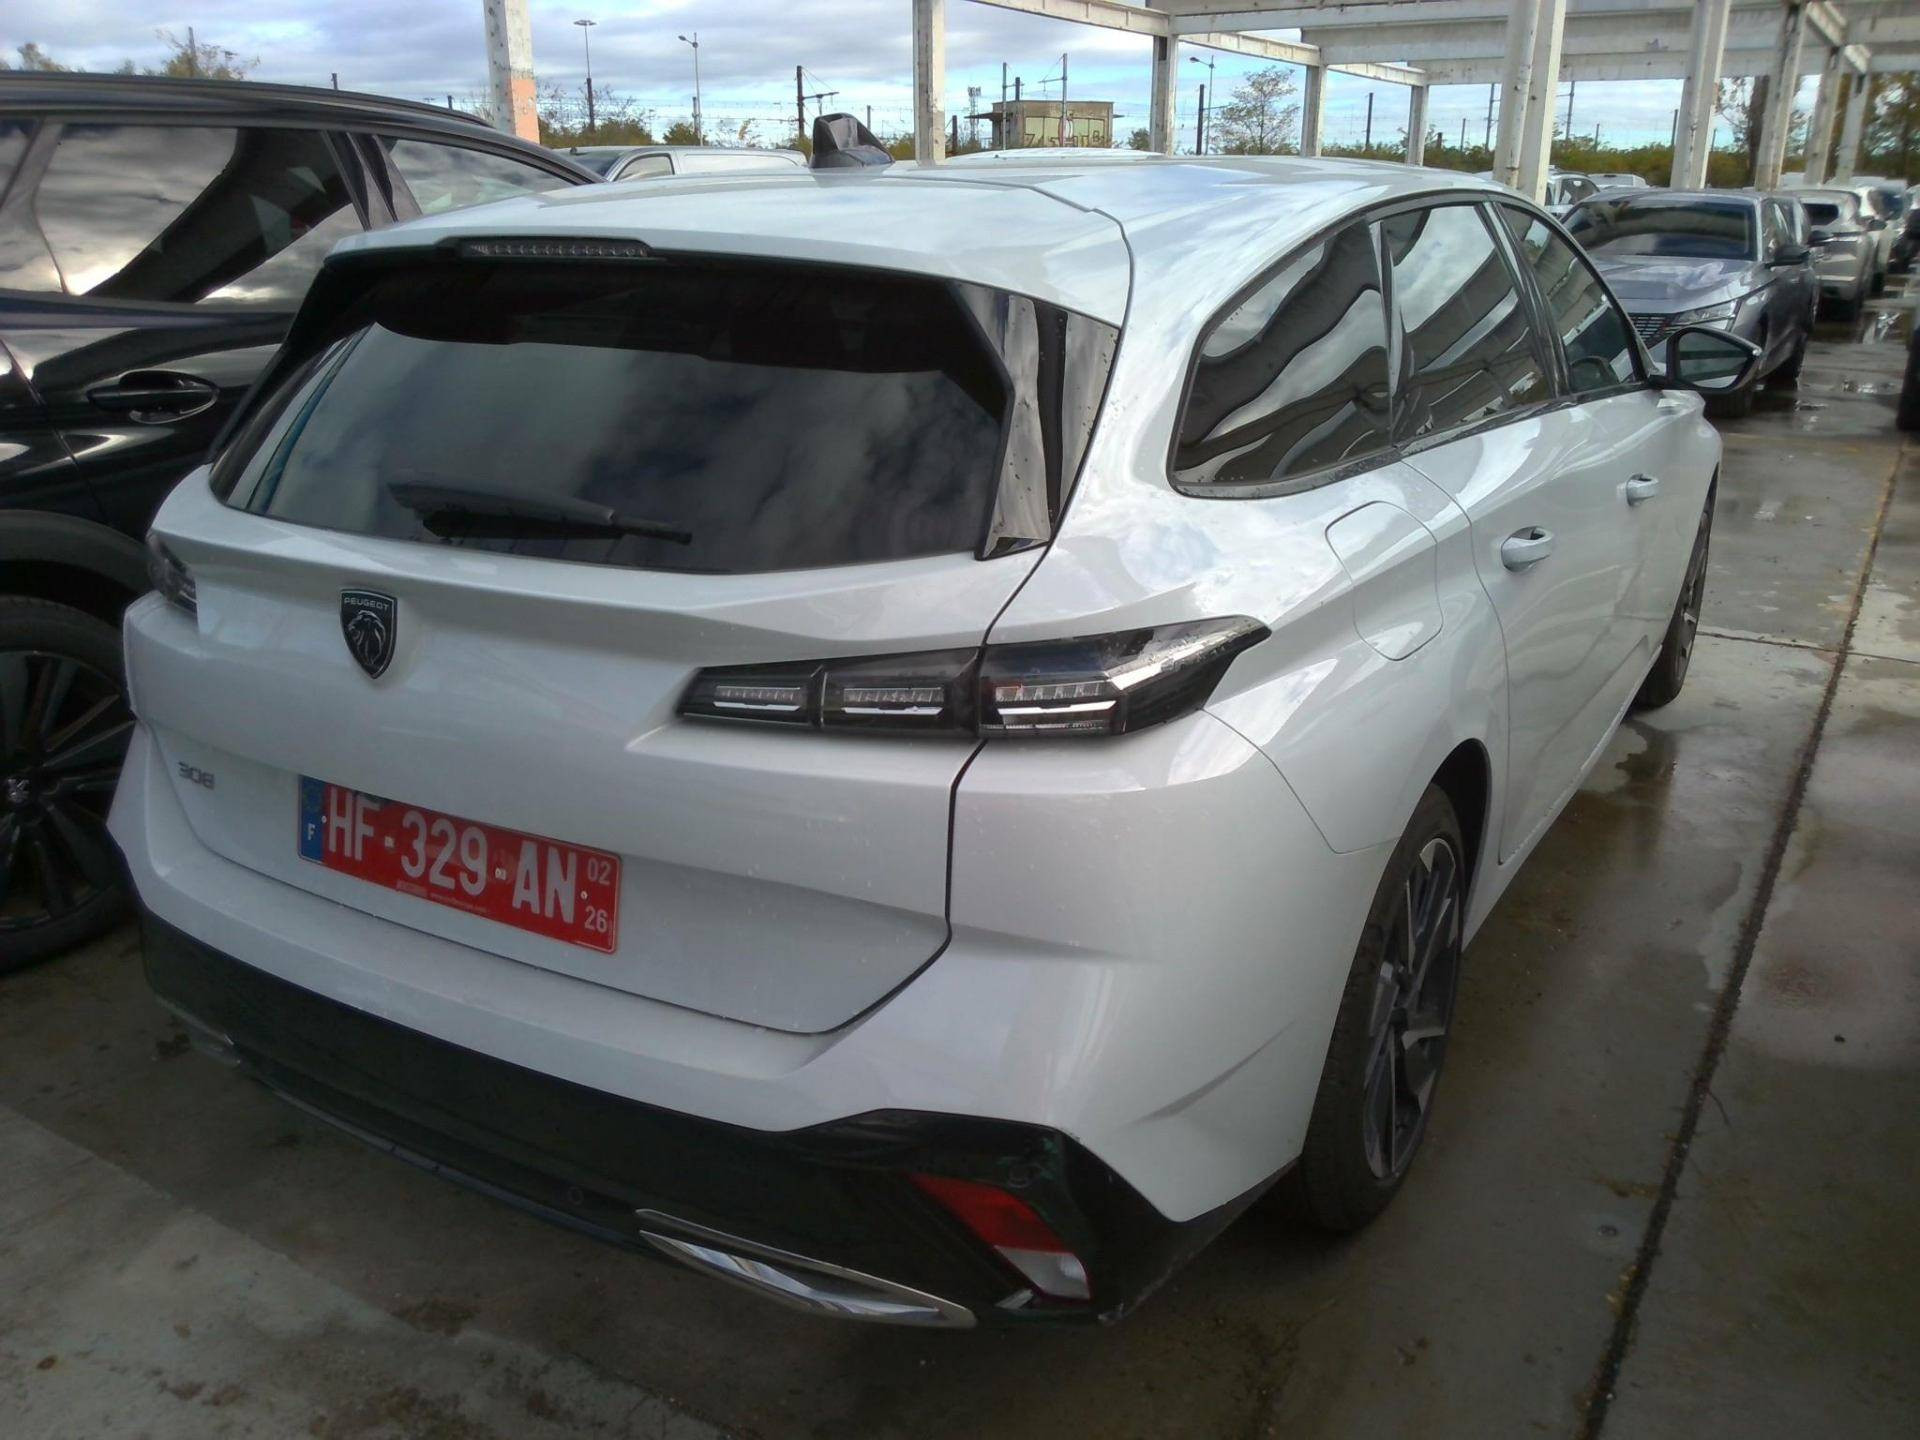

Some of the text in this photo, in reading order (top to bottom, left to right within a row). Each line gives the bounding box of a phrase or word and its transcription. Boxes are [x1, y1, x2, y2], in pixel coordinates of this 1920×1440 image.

[344, 597, 389, 611] PEUGEOT
[178, 761, 215, 790] 308
[307, 823, 316, 840] F
[587, 858, 611, 886] 02
[584, 905, 608, 934] 26
